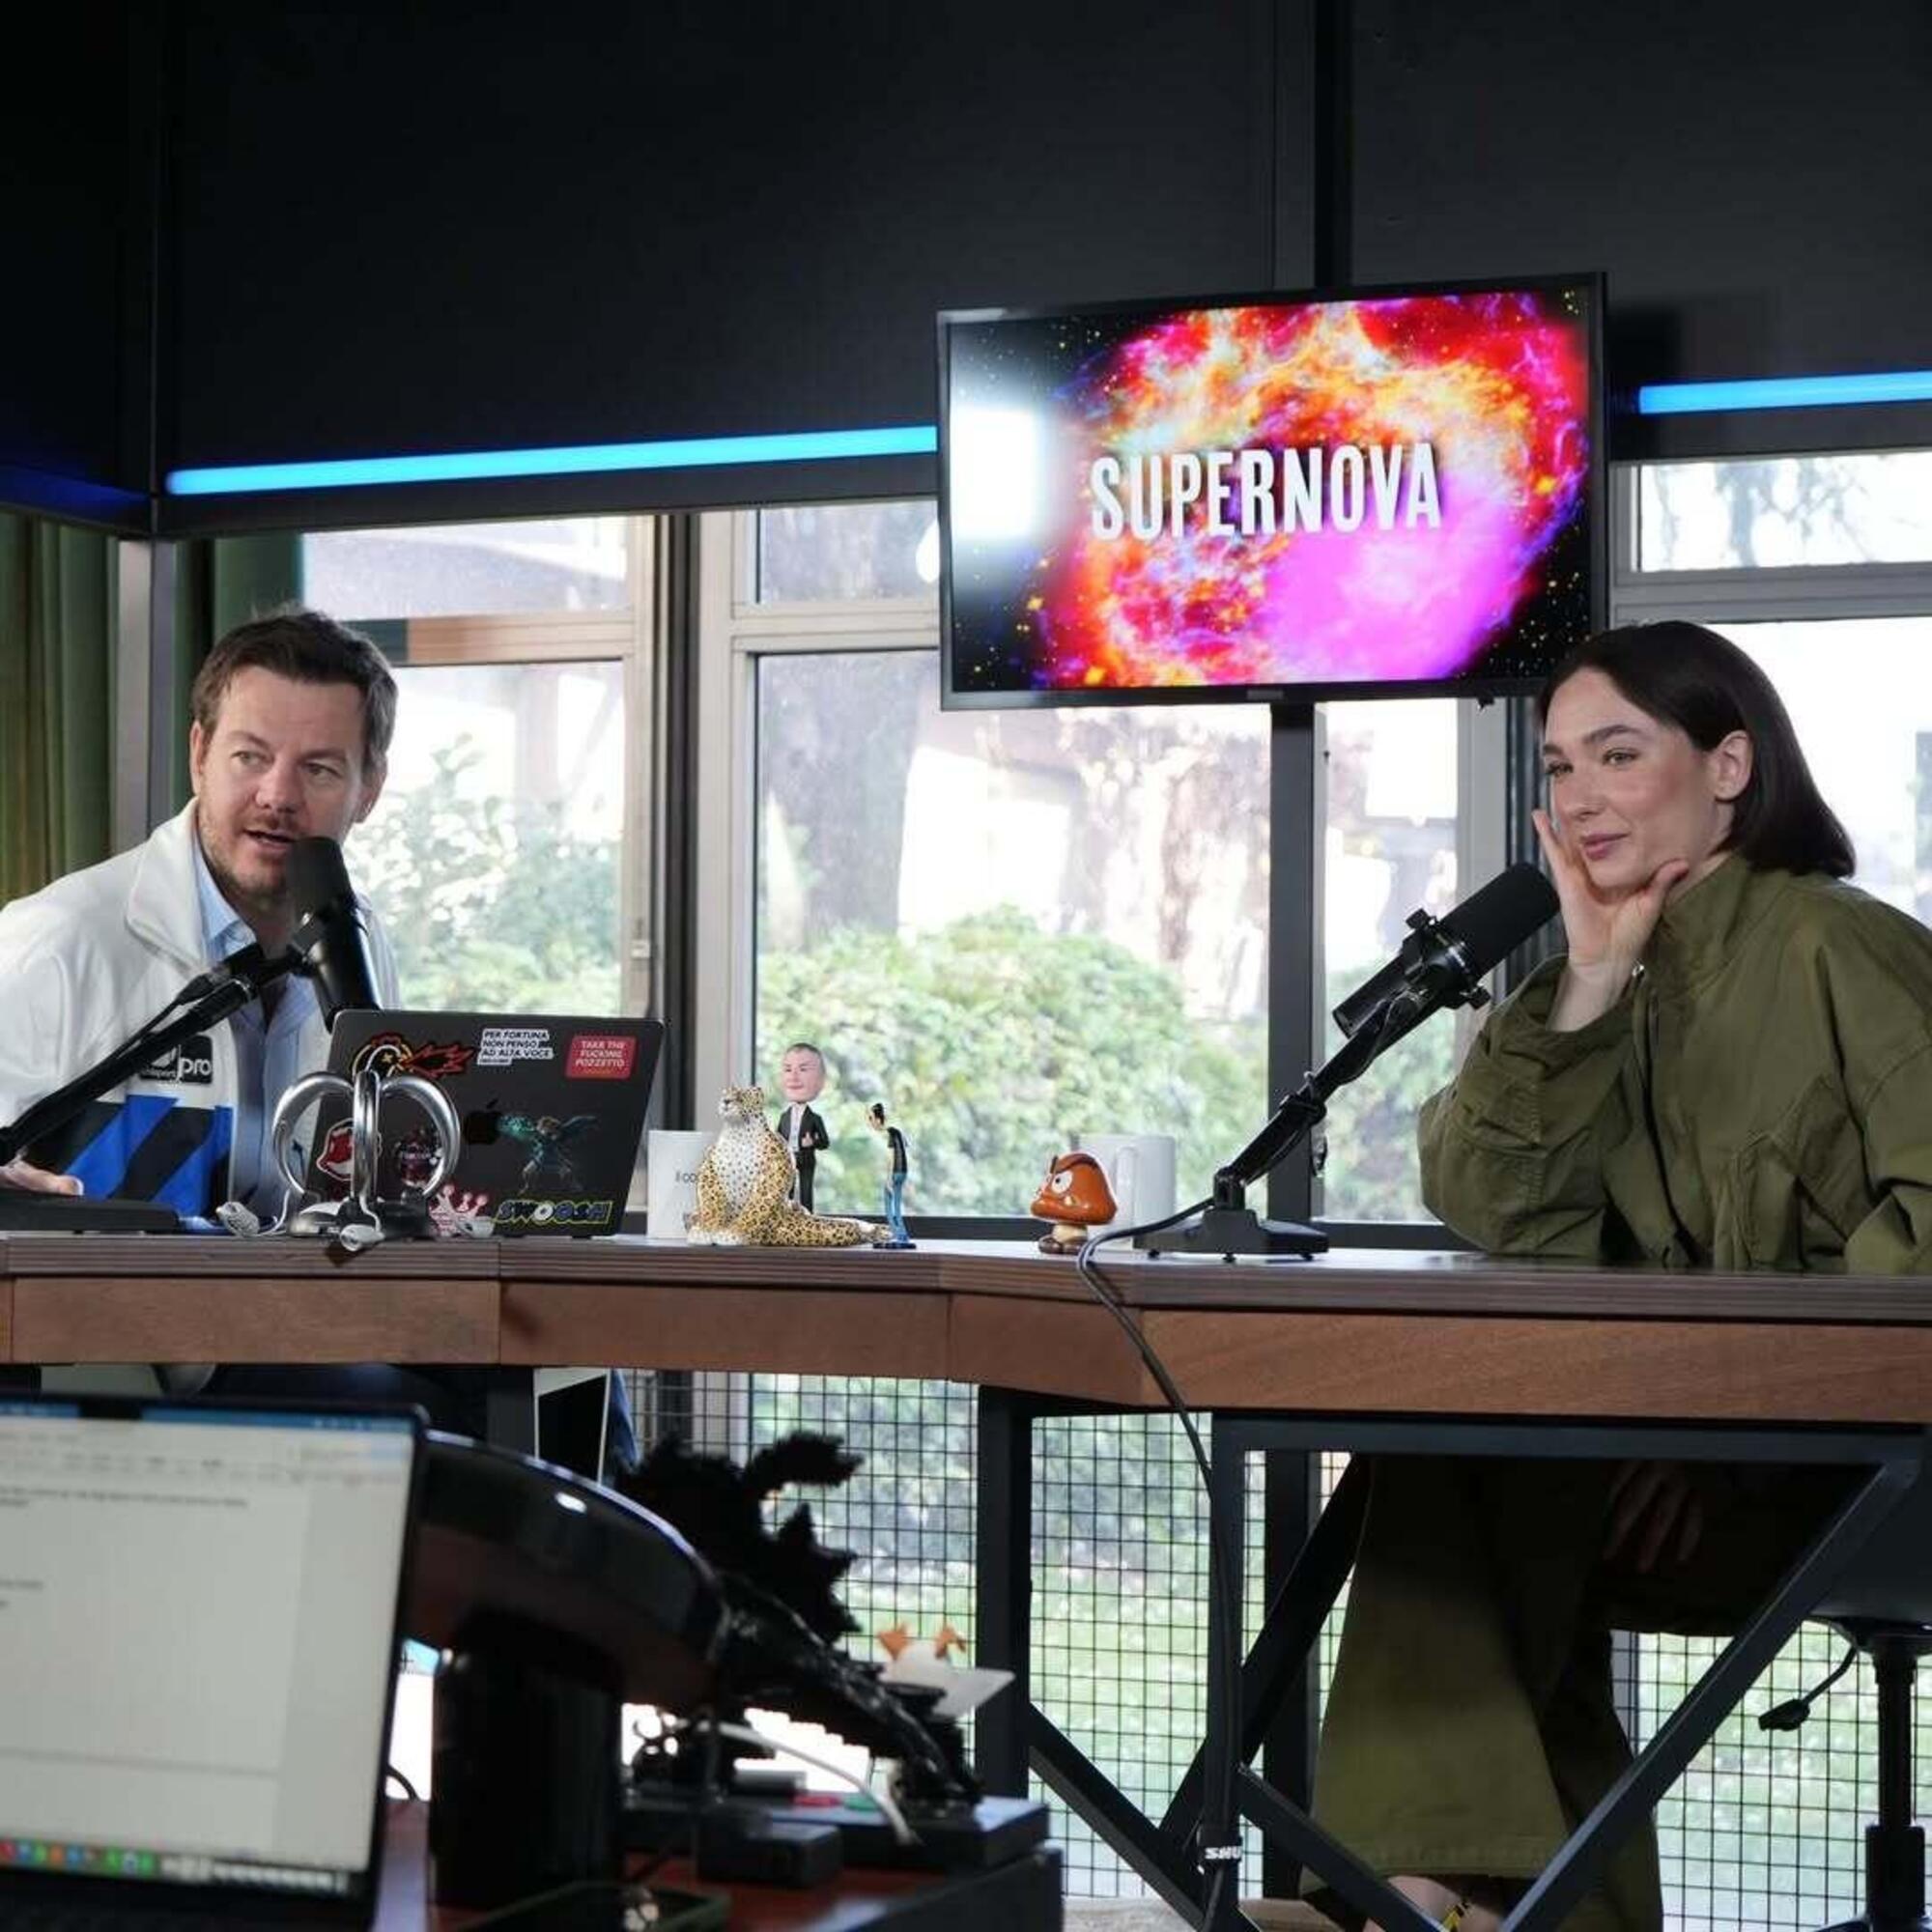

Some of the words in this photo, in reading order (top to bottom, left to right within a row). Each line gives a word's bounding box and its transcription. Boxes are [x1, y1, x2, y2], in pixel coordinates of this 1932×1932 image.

[1091, 442, 1442, 541] SUPERNOVA
[484, 1031, 501, 1039] PER
[502, 1031, 547, 1039] FORTUNA
[506, 1040, 537, 1049] PENSO
[582, 1040, 605, 1049] TAKE
[524, 1049, 550, 1058] VOCE
[575, 1058, 625, 1067] POZZETTO
[177, 1057, 212, 1081] pro
[496, 1200, 611, 1224] SWOOSH
